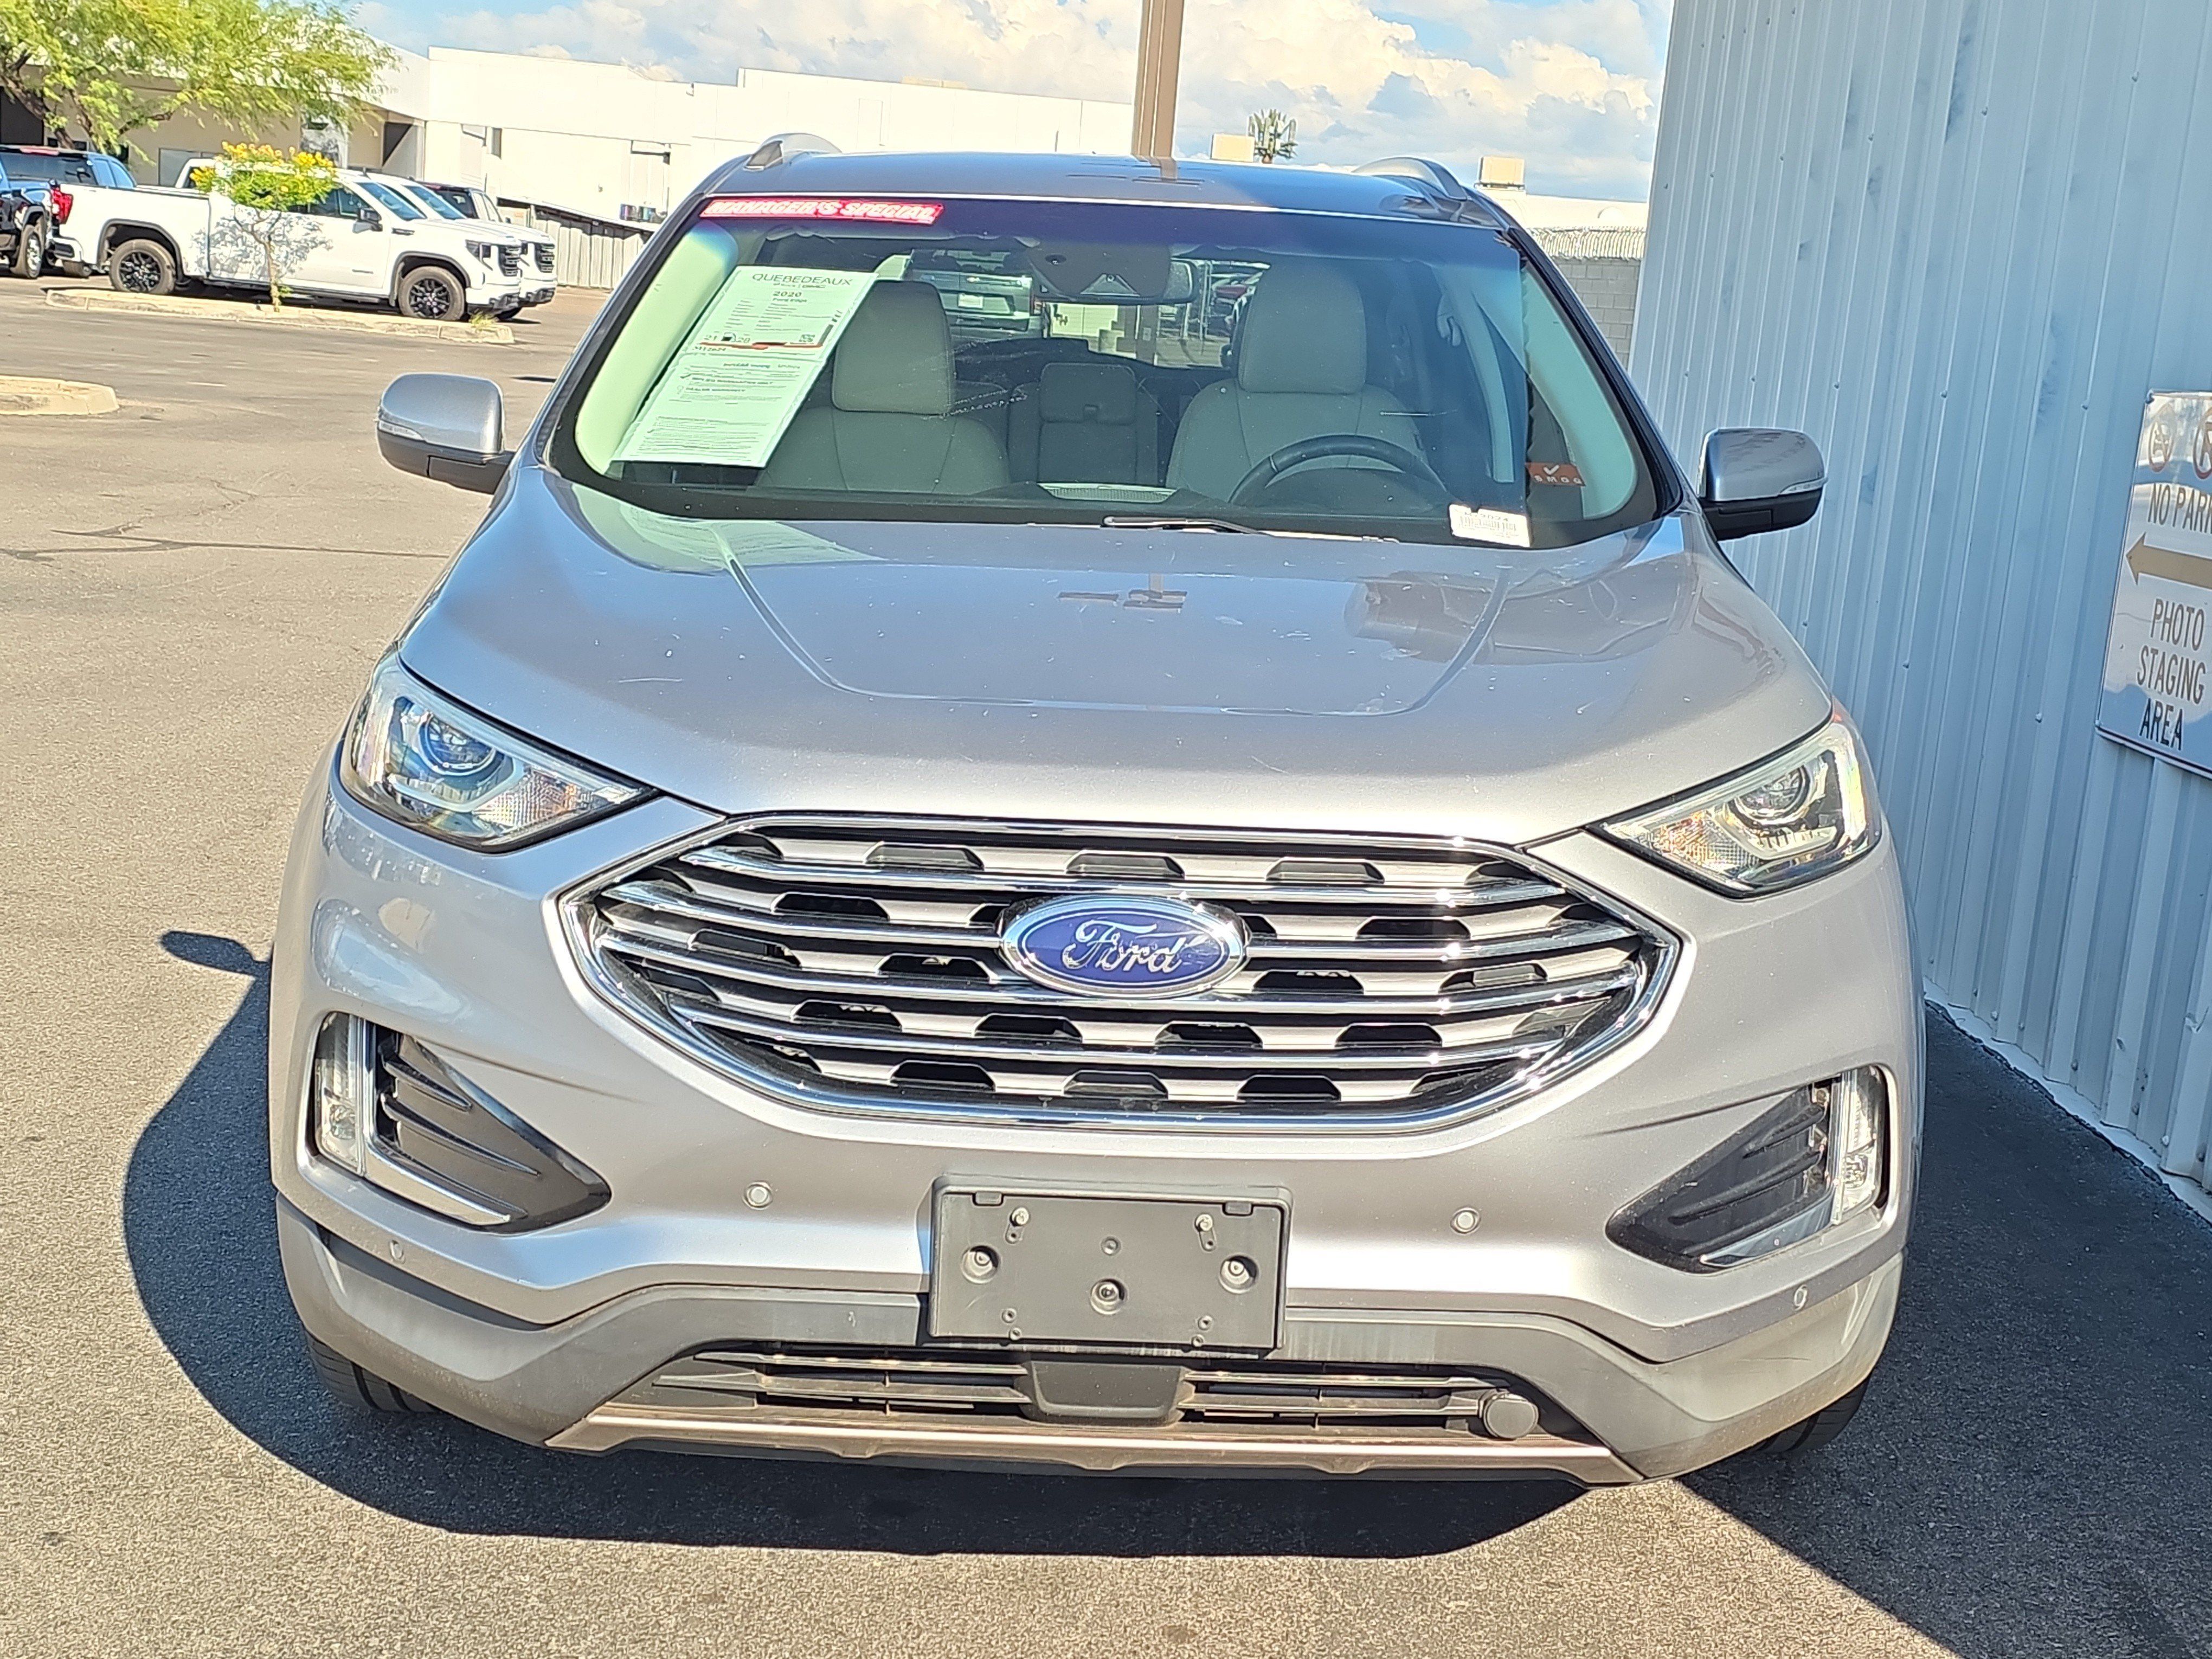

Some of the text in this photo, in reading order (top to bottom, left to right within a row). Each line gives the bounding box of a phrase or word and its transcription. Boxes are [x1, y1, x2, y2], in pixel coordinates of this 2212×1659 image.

[704, 201, 936, 219] MANAGER'S SPECIAL
[752, 273, 853, 285] QUEBEDEAUX
[2147, 483, 2171, 525] NO
[2150, 598, 2205, 652] PHOTO
[2137, 645, 2205, 704] STAGING
[2139, 697, 2184, 750] AREA
[1062, 919, 1195, 974] Ford
